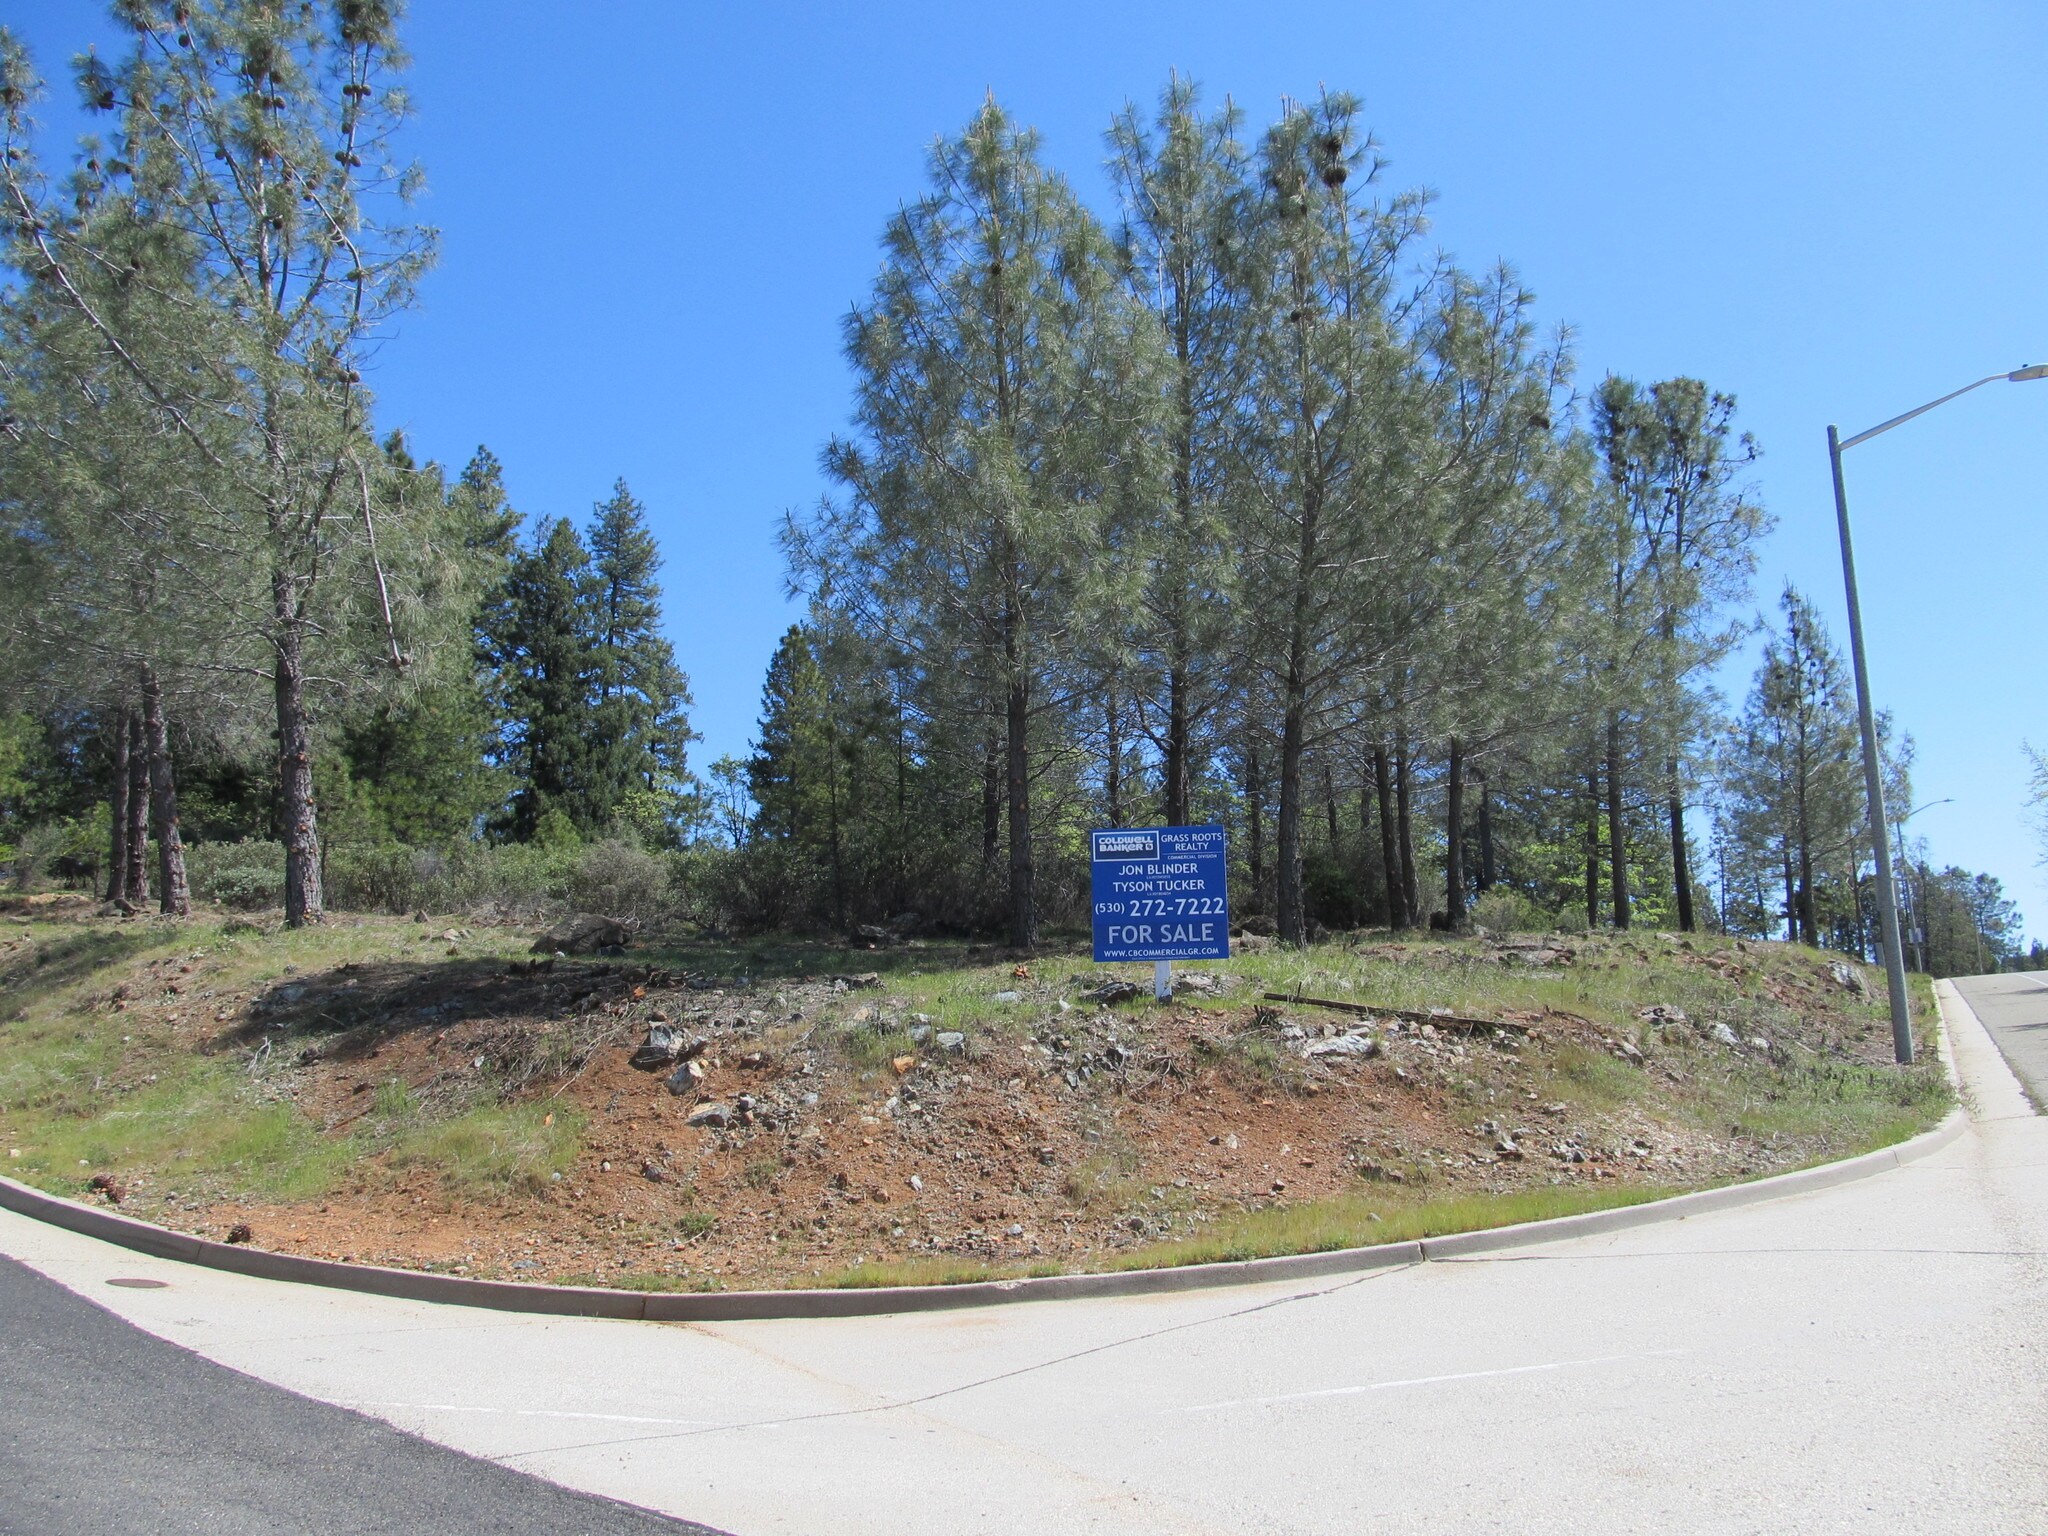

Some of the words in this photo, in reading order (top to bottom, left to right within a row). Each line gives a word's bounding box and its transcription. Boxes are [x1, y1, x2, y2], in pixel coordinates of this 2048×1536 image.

[1161, 834, 1189, 843] GRASS
[1192, 832, 1222, 841] ROOTS
[1175, 842, 1209, 851] REALTY
[1119, 865, 1143, 876] JON
[1147, 863, 1198, 874] BLINDER
[1113, 881, 1153, 893] TYSON
[1156, 880, 1205, 891] TUCKER
[1095, 902, 1125, 915] (530)
[1130, 897, 1225, 917] 272-7222
[1108, 924, 1153, 944] FOR
[1160, 923, 1214, 943] SALE
[1103, 947, 1219, 957] WWW.CBCOMMERCIALGR.COM
